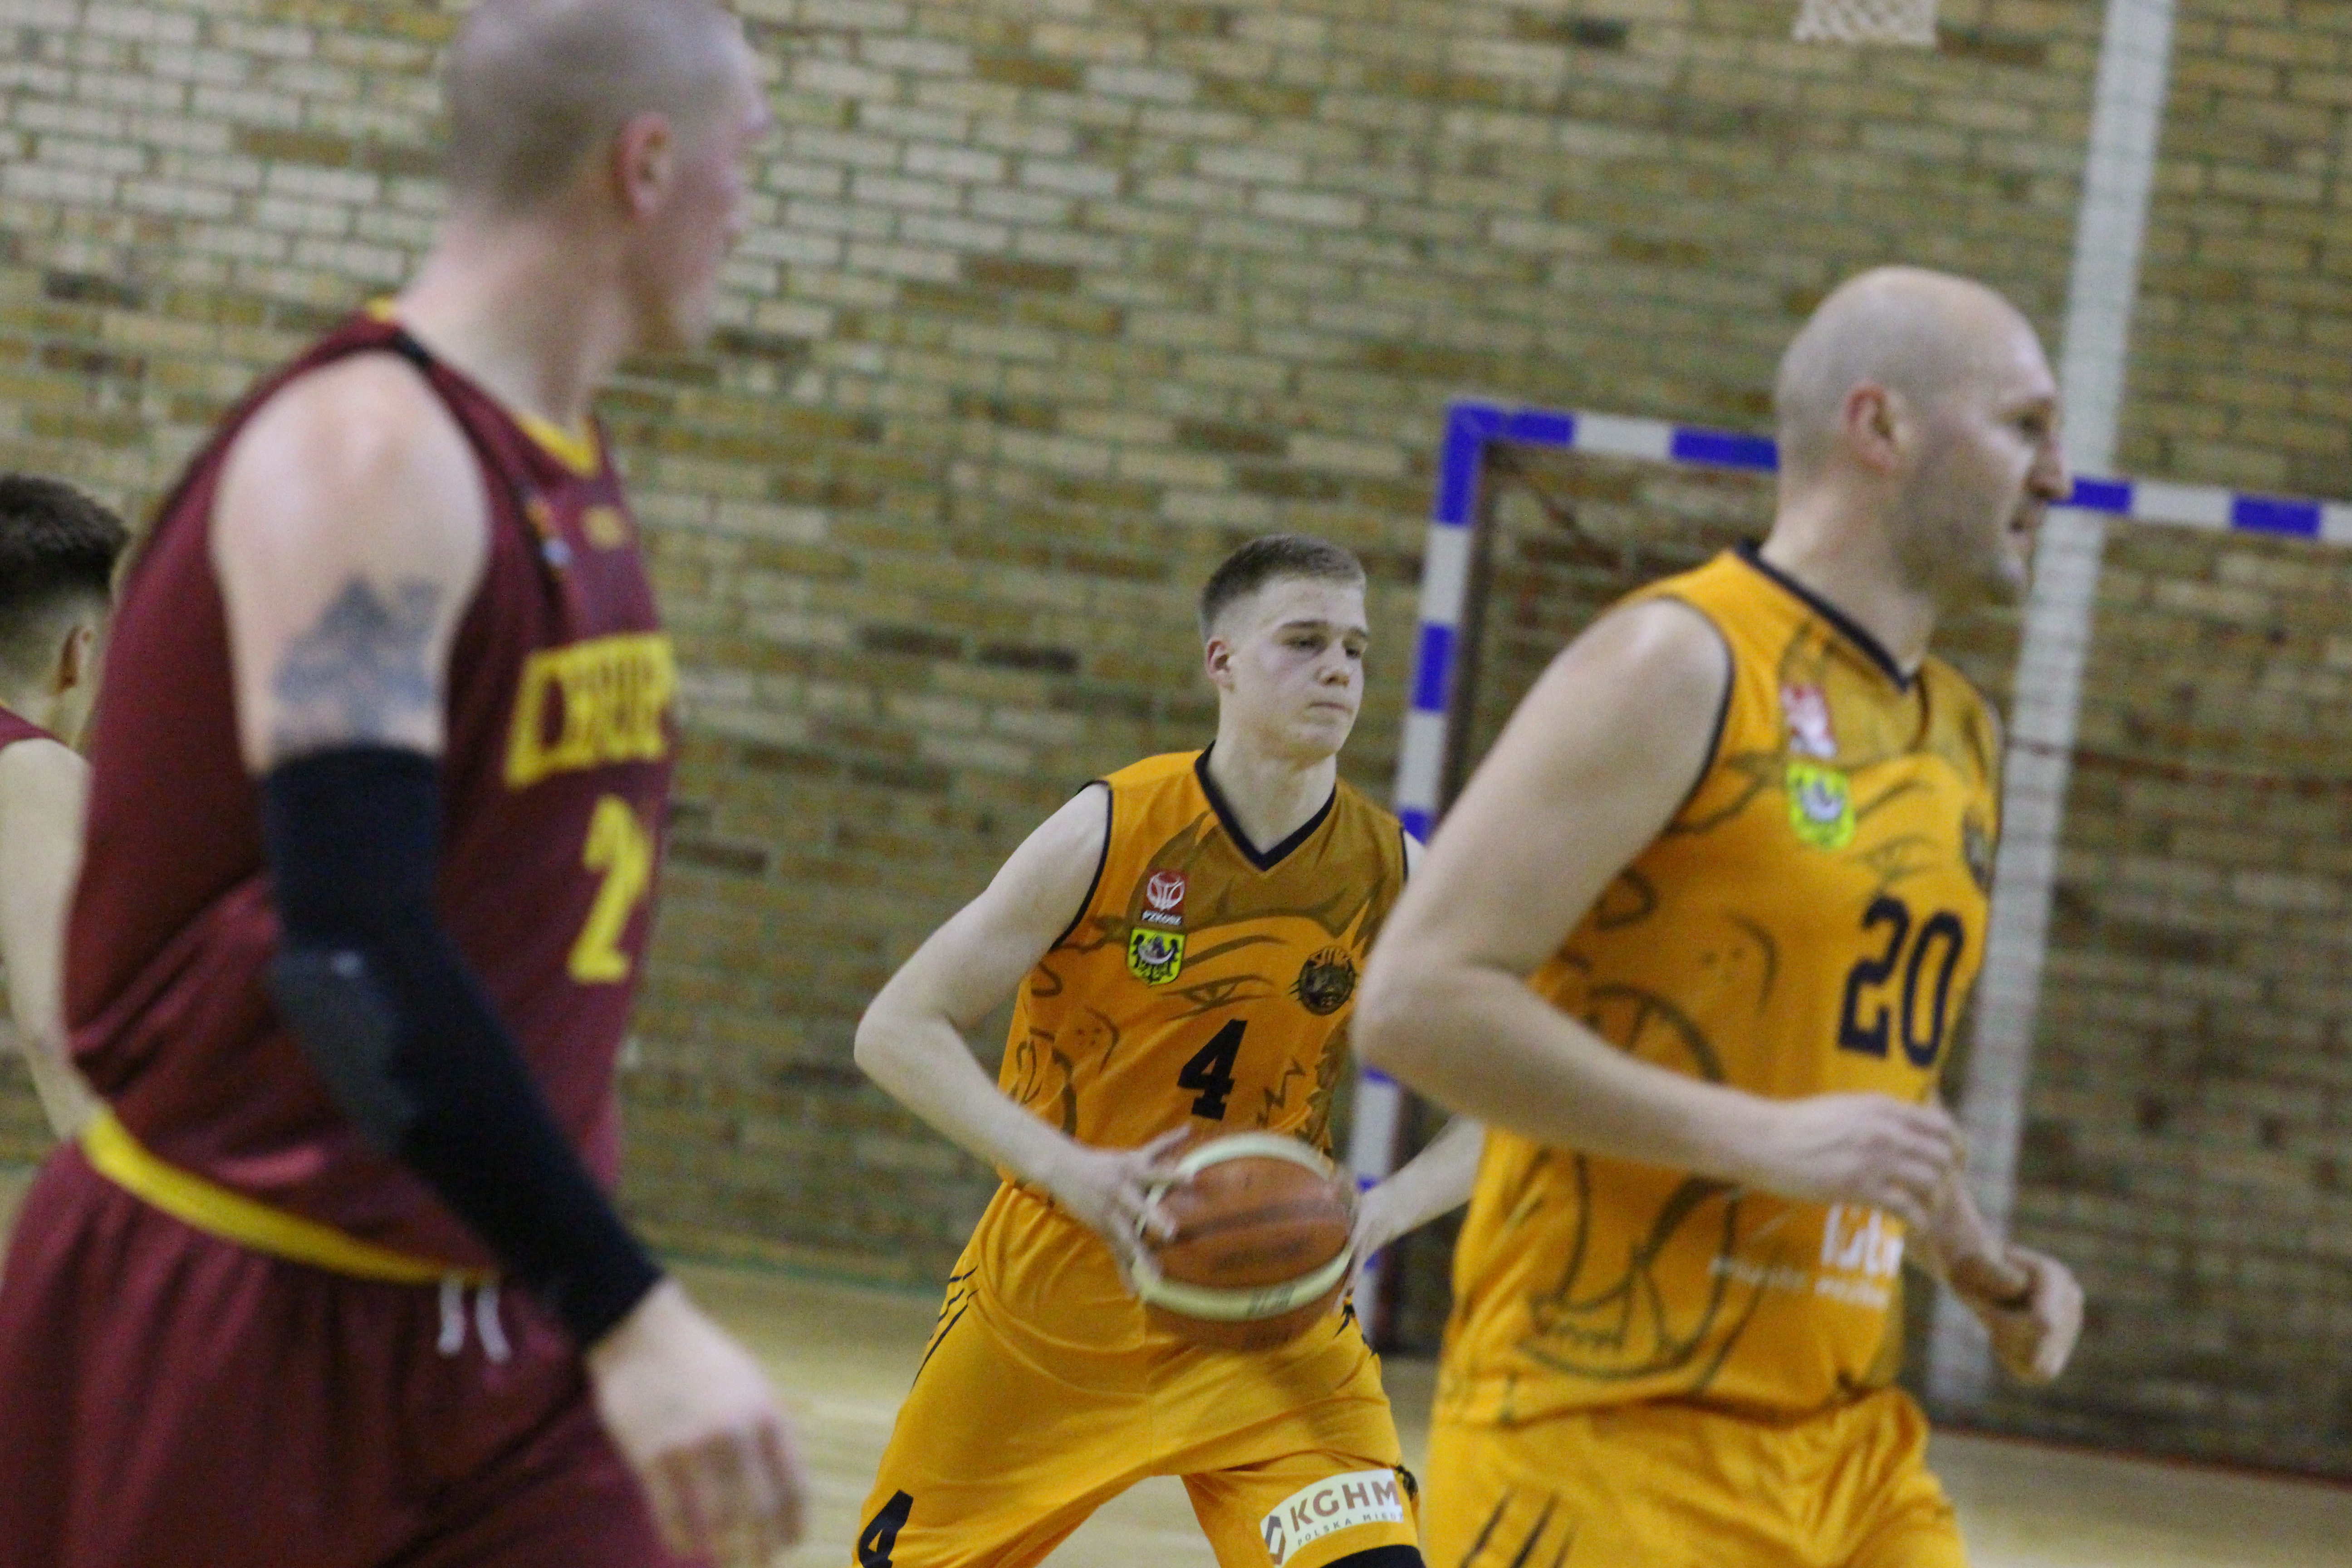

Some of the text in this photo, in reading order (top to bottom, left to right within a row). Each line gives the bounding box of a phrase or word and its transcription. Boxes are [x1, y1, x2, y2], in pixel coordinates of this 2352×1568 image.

[1838, 896, 1965, 1068] 20
[1177, 1019, 1247, 1121] 4
[858, 1489, 914, 1568] 4
[1290, 1480, 1401, 1533] KGHM
[1298, 1518, 1352, 1546] POLSKA
